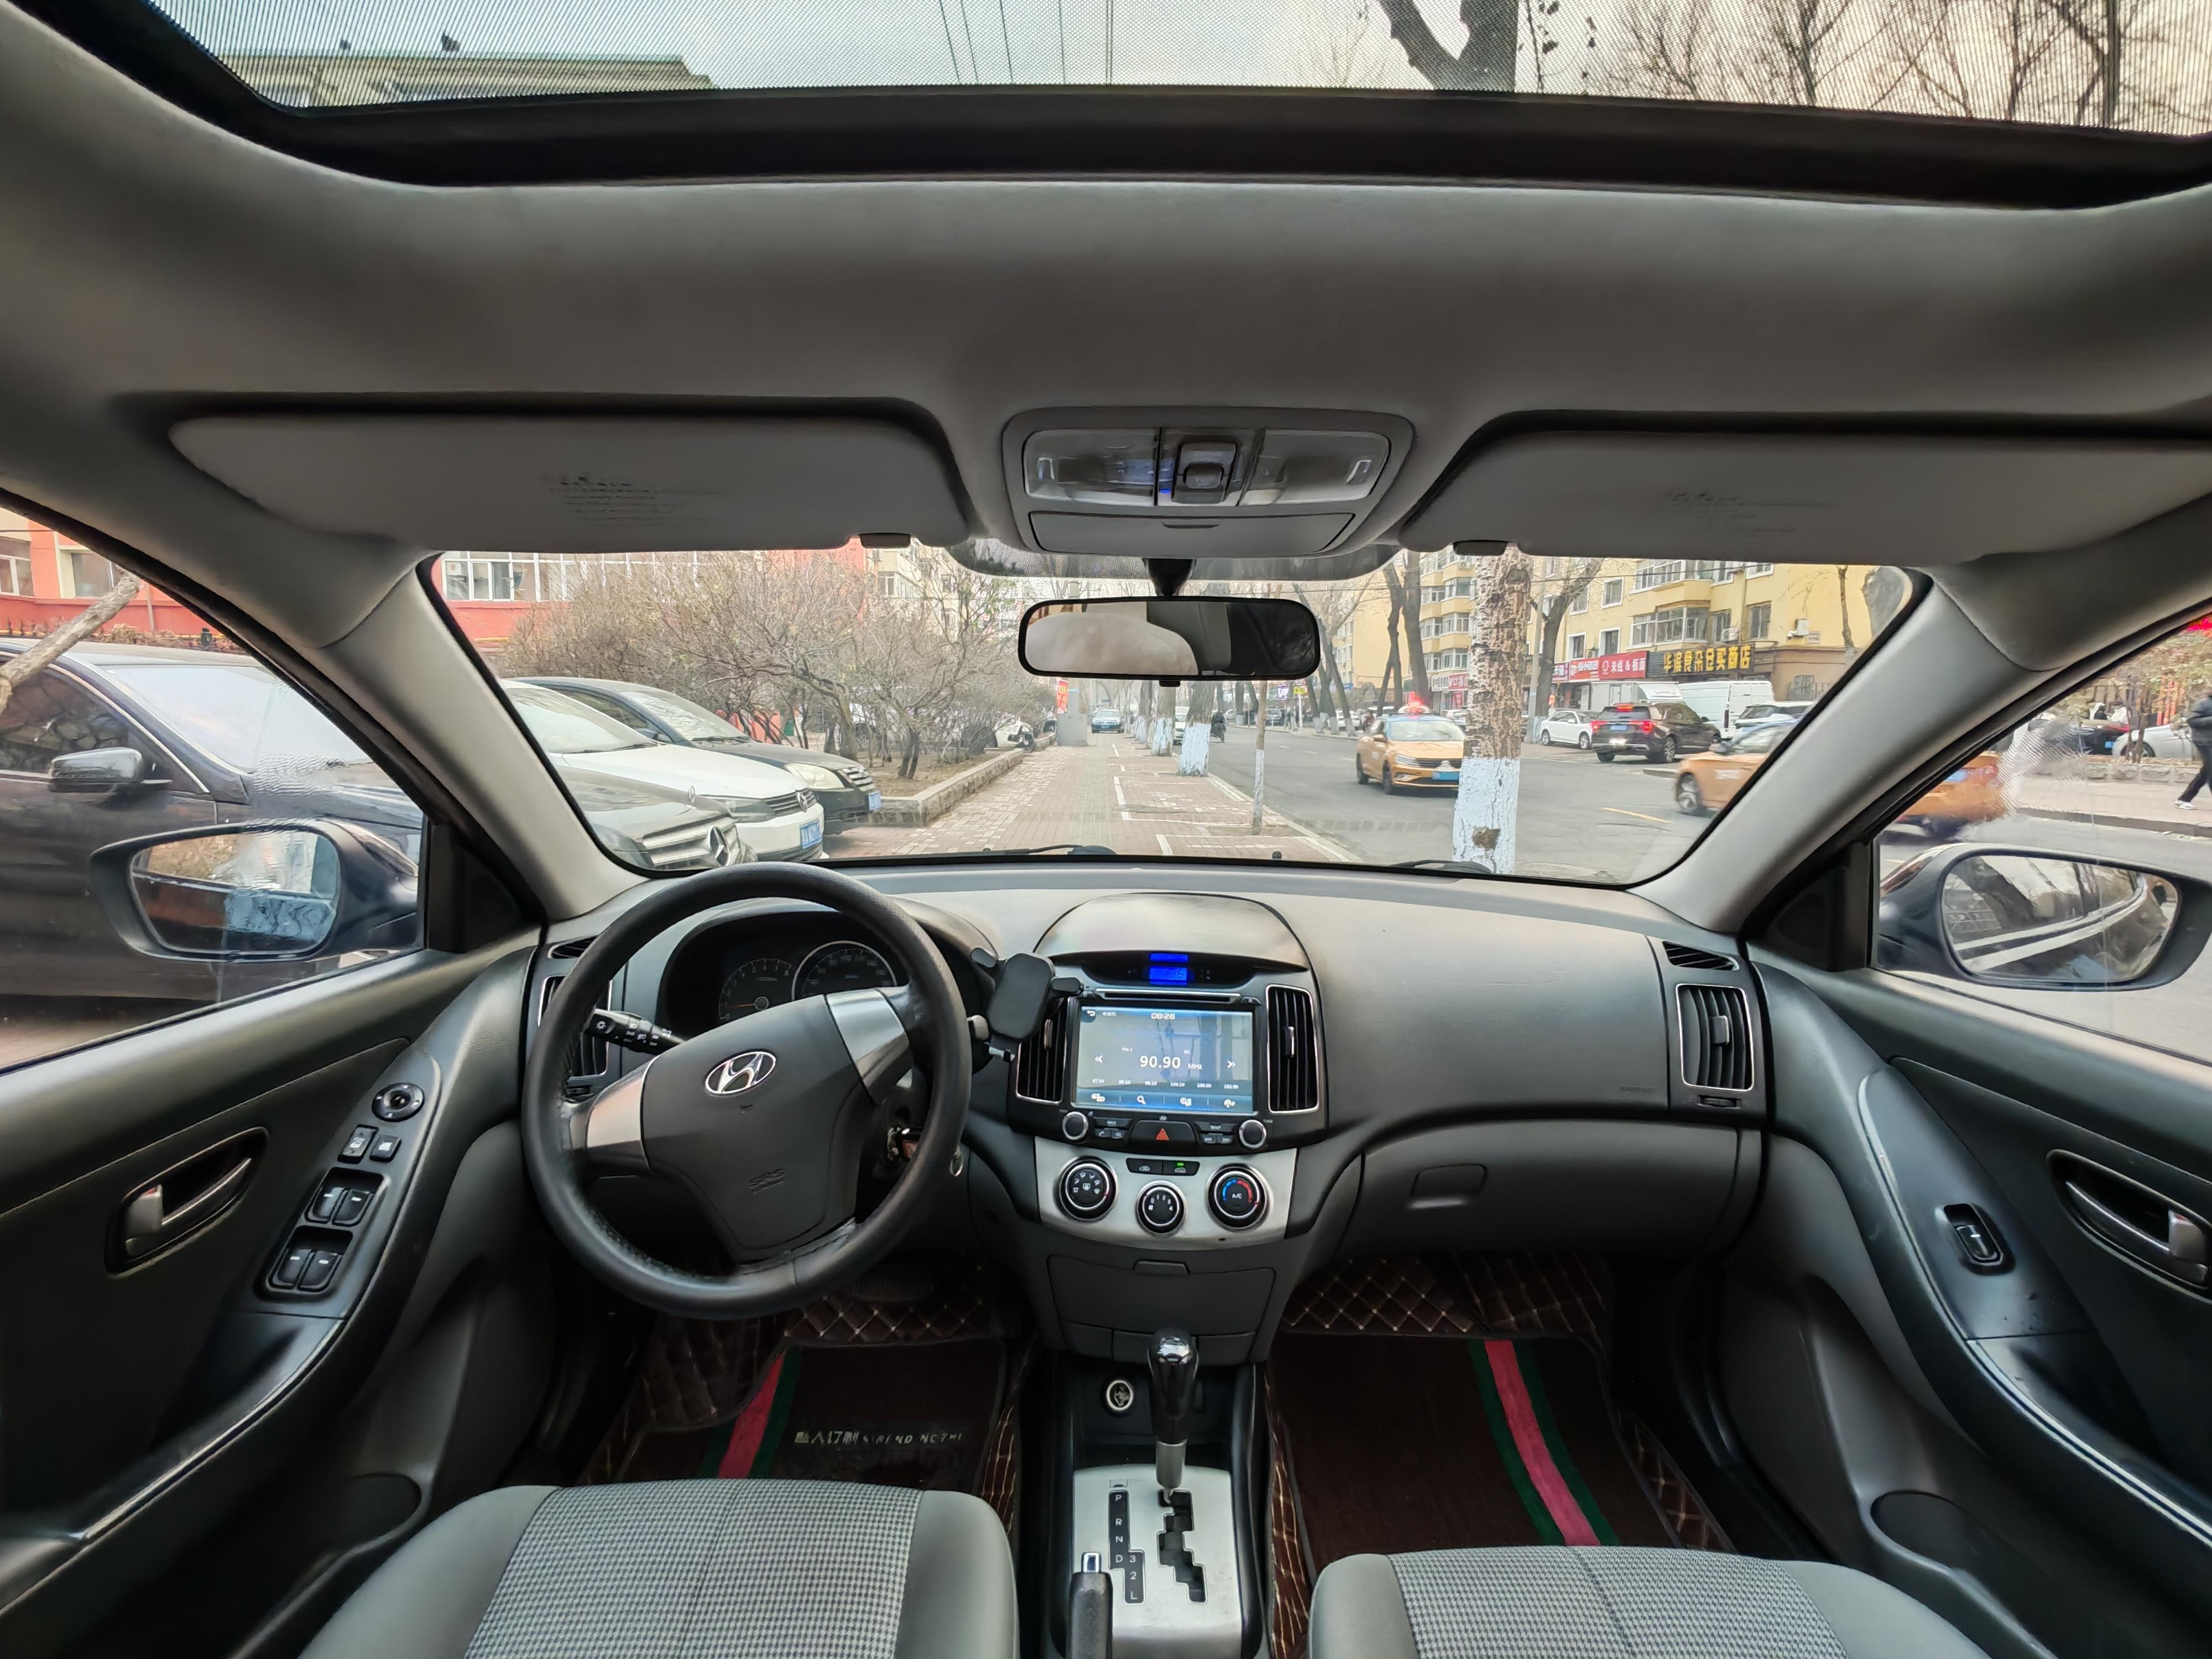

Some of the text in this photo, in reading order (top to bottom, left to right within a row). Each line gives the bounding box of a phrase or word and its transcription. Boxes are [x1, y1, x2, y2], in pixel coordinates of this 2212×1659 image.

[1140, 1055, 1181, 1069] 90.90
[1115, 1494, 1122, 1503] P
[1115, 1518, 1123, 1526] R
[1115, 1554, 1123, 1563] D
[1129, 1554, 1136, 1563] 3
[1130, 1571, 1137, 1580] 2
[1130, 1591, 1138, 1600] L
